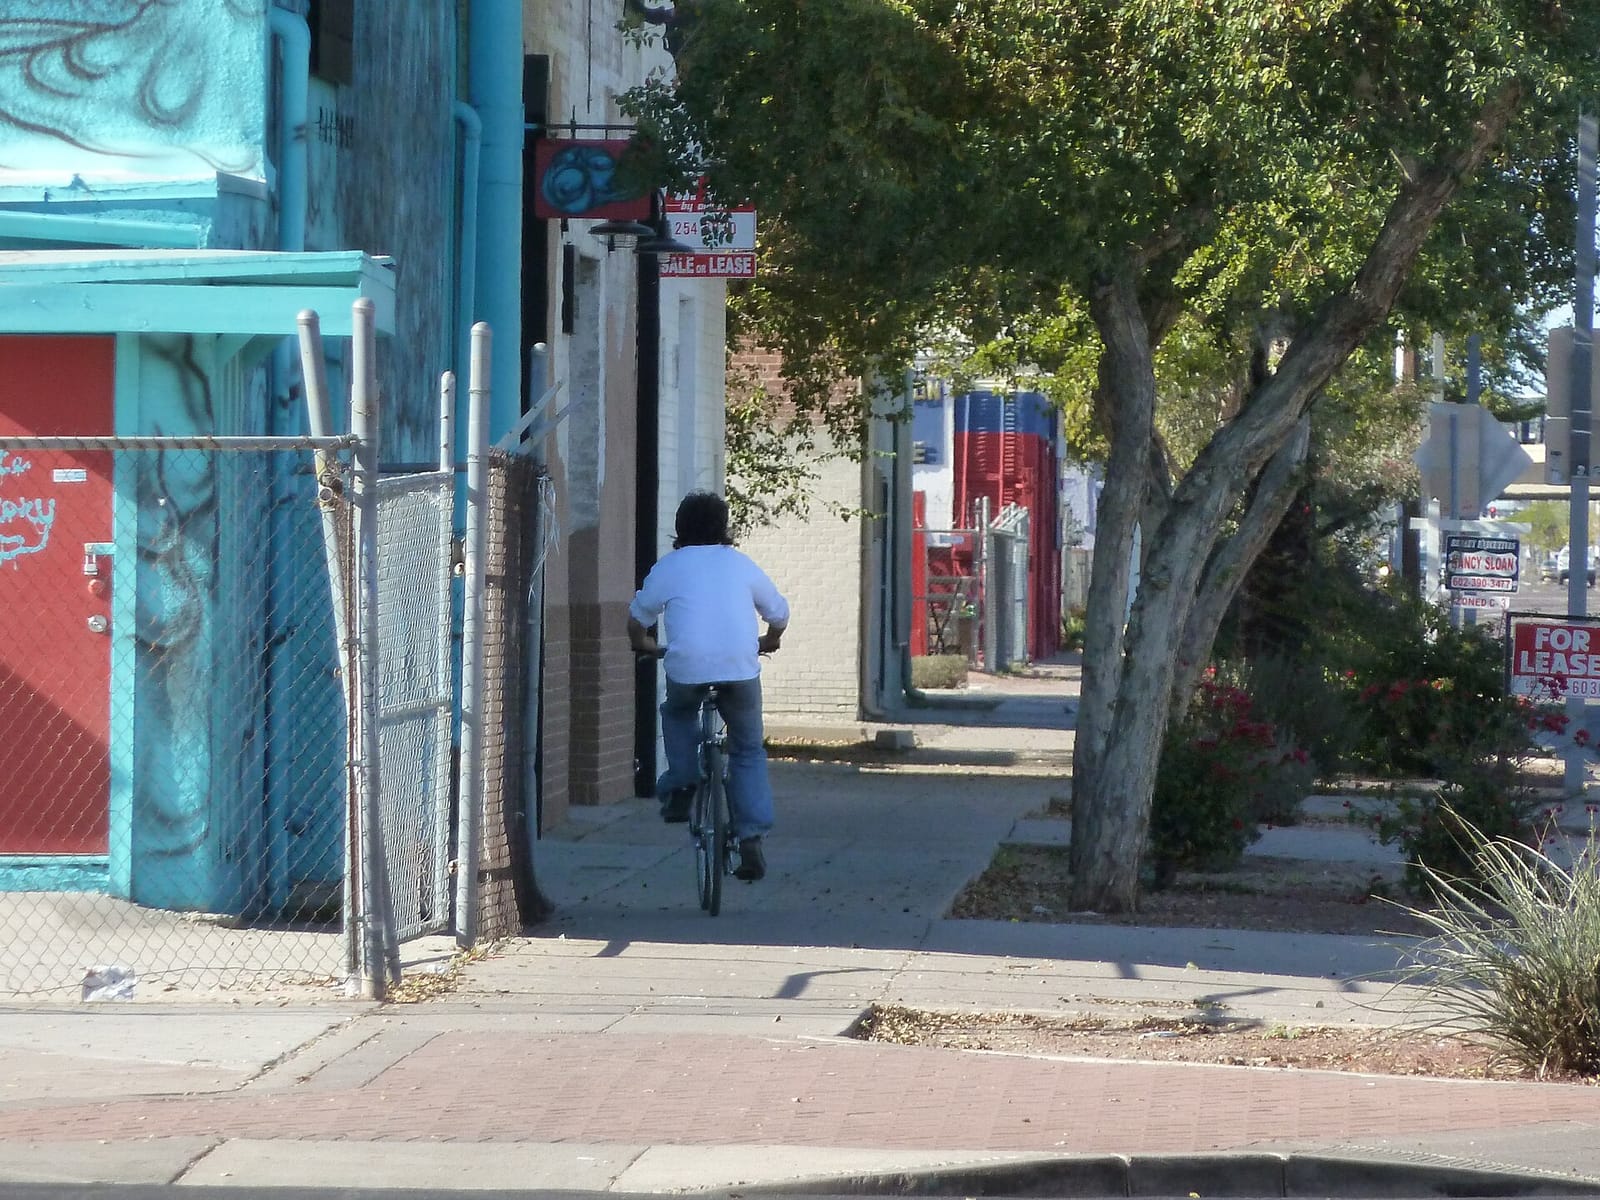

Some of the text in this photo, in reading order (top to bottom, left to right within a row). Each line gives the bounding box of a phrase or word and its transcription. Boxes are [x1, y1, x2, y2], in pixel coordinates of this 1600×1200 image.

[675, 221, 698, 235] 254
[709, 257, 752, 274] LEASE
[1484, 556, 1515, 571] SLOAN
[1535, 627, 1590, 652] FOR
[1520, 651, 1600, 676] LEASE
[1571, 680, 1600, 696] 603
